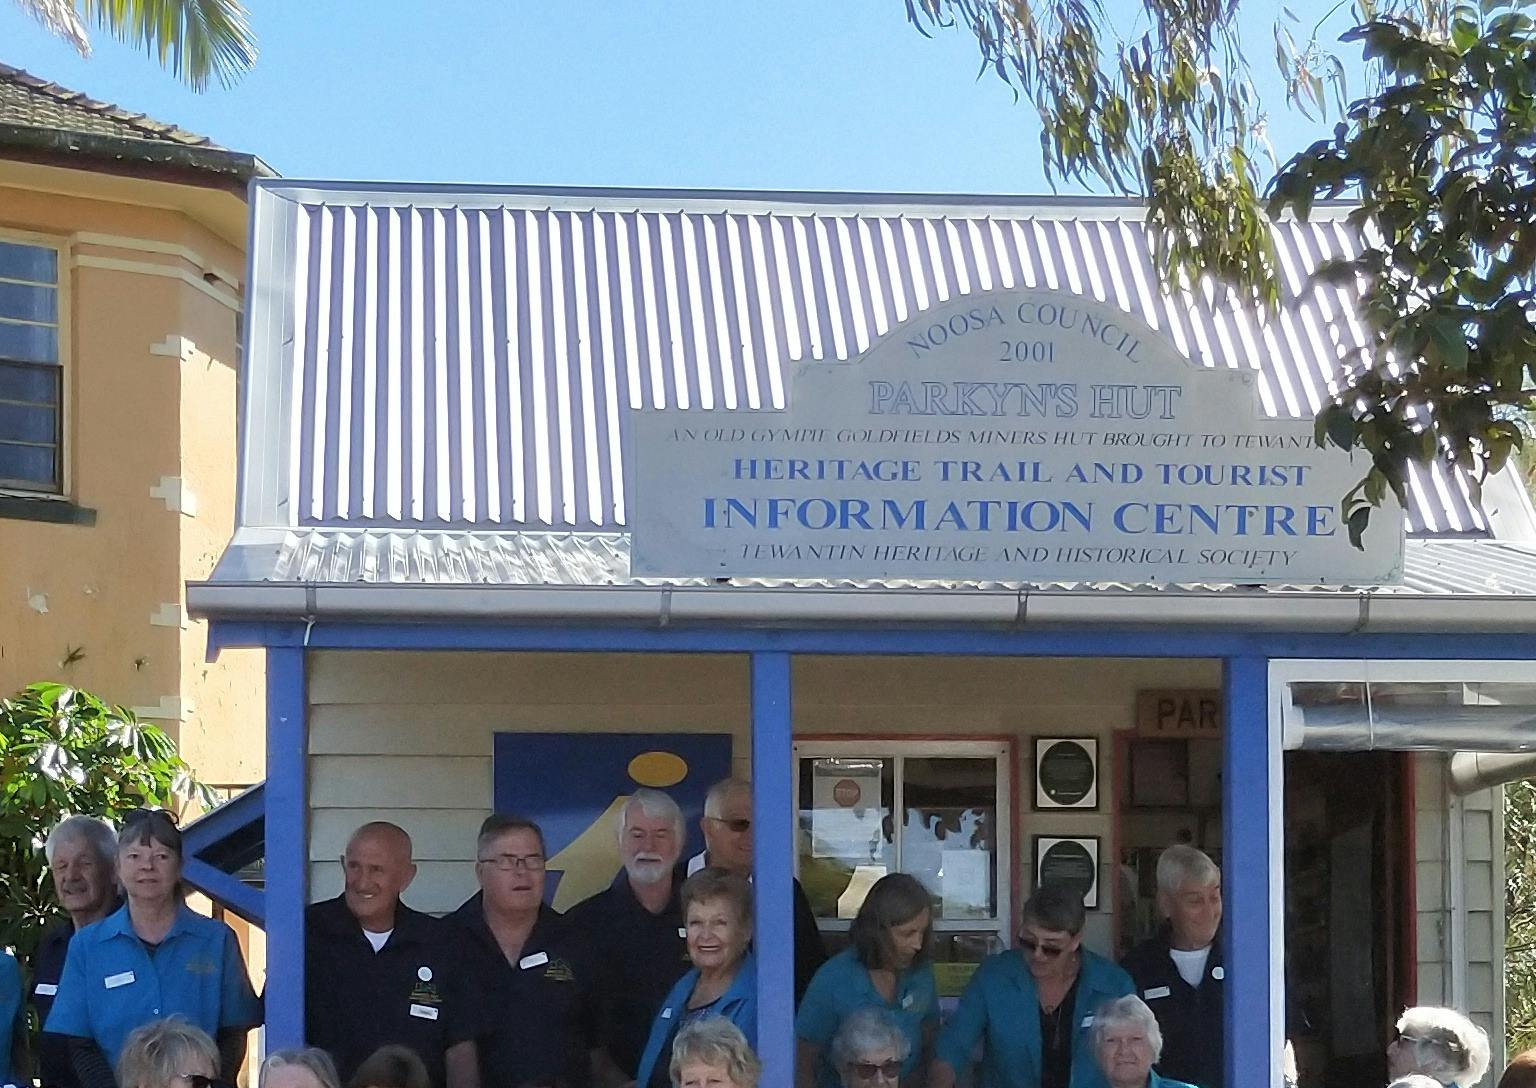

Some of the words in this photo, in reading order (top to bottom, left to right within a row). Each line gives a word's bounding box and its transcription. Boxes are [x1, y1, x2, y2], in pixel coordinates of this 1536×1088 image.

[907, 306, 1006, 359] NOOSA
[1017, 302, 1143, 363] COUNCIL
[999, 341, 1054, 363] 2001
[868, 380, 1079, 418] PARKYN'S
[1089, 383, 1182, 420] HUT
[669, 428, 698, 442] AN
[704, 428, 745, 443] OLD
[836, 428, 961, 444] GOLDFIELDS
[967, 430, 1048, 445] MINERS
[1054, 431, 1098, 446] HUT
[1102, 432, 1193, 448] BROUGHT
[1200, 433, 1226, 449] TO
[733, 458, 922, 482] HERITAGE
[934, 460, 1054, 483] TRAIL
[1065, 462, 1144, 484] AND
[1155, 463, 1312, 487] TOURIST
[703, 497, 1093, 533] INFORMATION
[1113, 502, 1337, 537] CENTRE
[741, 544, 865, 561] TEWANTIN
[873, 545, 990, 562] HERITAGE
[1001, 547, 1049, 563] AND
[1056, 547, 1186, 565] HISTORICAL
[1198, 548, 1299, 568] SOCIETY
